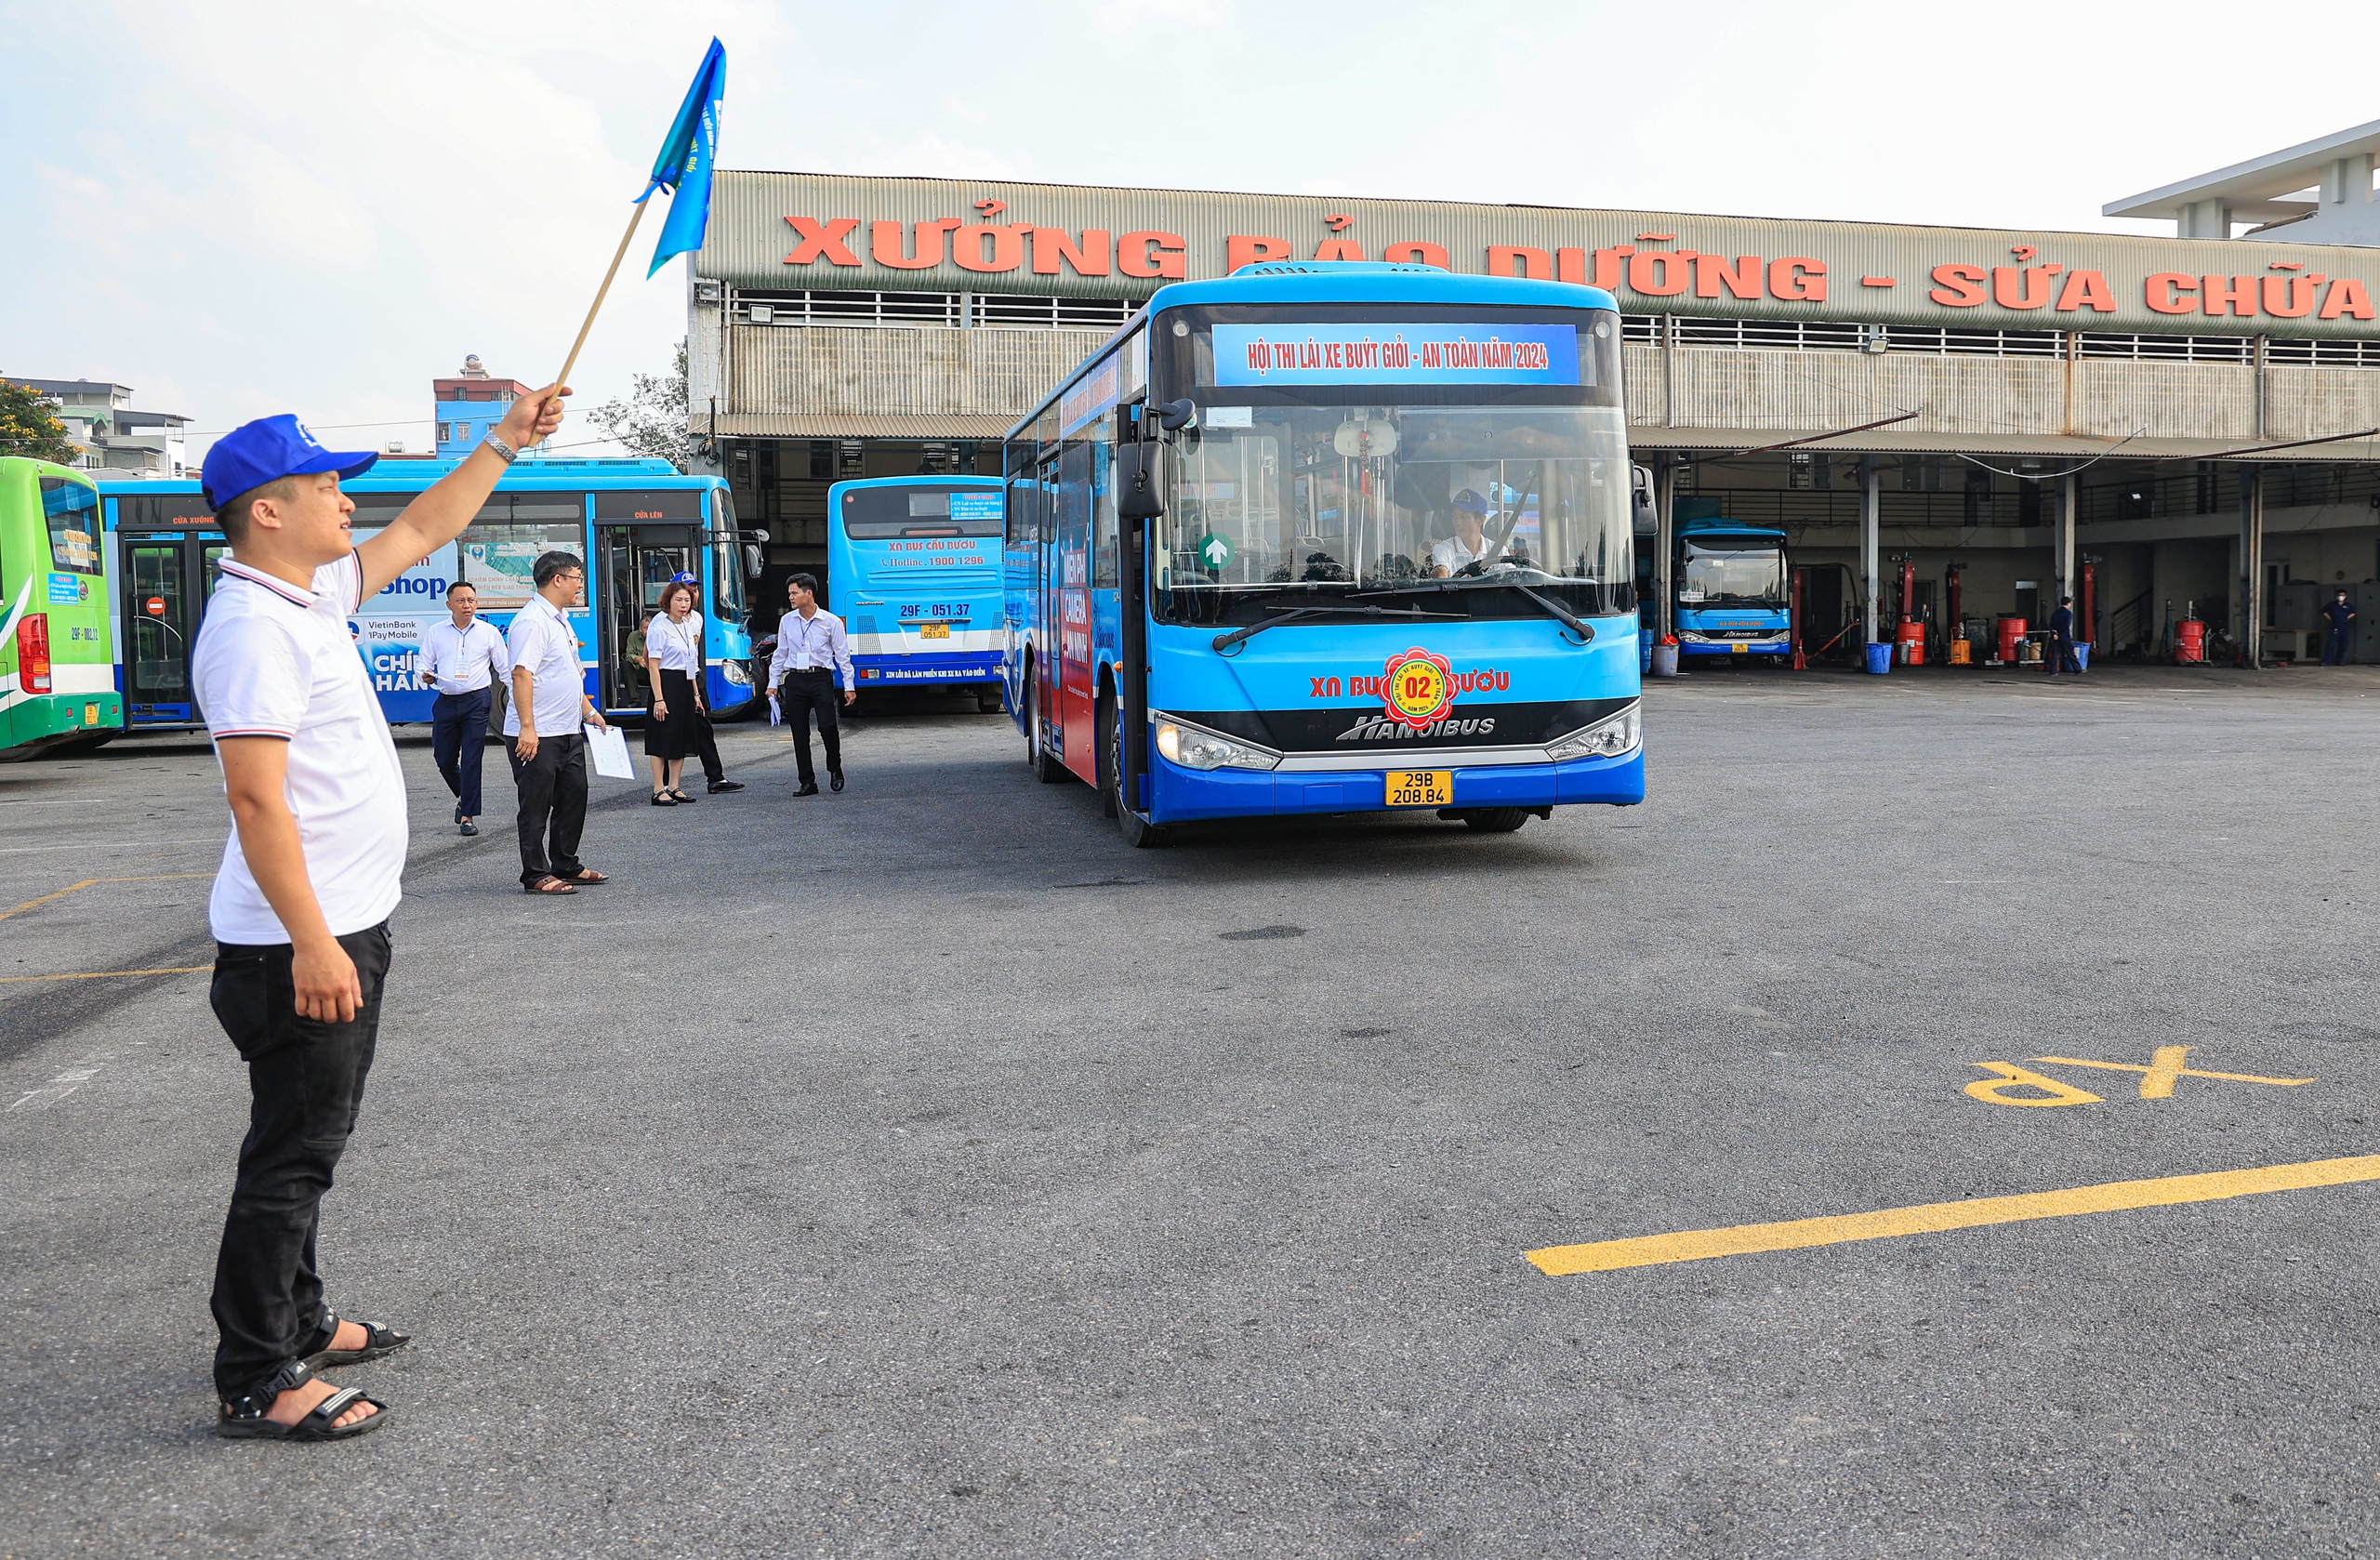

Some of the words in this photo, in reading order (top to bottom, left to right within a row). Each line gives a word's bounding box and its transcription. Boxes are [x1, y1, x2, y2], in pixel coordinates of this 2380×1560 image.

[783, 200, 1186, 279] XƯỞNG
[1488, 231, 1828, 302] DƯỠNG
[1929, 245, 2117, 312] SỬA
[2145, 261, 2376, 320] CHỮA
[1247, 337, 1272, 376] HỘI
[1274, 342, 1297, 369] THI
[1299, 337, 1322, 369] LÁI
[1324, 342, 1342, 369] XE
[1345, 338, 1379, 369] BUÝT
[1381, 334, 1410, 369] GIỎI
[1421, 342, 1441, 368] AN
[1443, 337, 1479, 368] TOÀN
[1481, 337, 1513, 368] NĂM
[1514, 342, 1549, 369] 2024
[906, 541, 923, 550] BUS
[929, 557, 955, 565] 1900
[959, 556, 984, 564] 1296
[901, 605, 920, 616] 29F
[932, 604, 970, 615] 051.37
[374, 650, 421, 672] CHÍ
[1309, 677, 1341, 696] XN
[1350, 676, 1379, 696] BU
[1406, 677, 1431, 699] 02
[1405, 773, 1433, 787] 29B
[1393, 789, 1444, 803] 208.84
